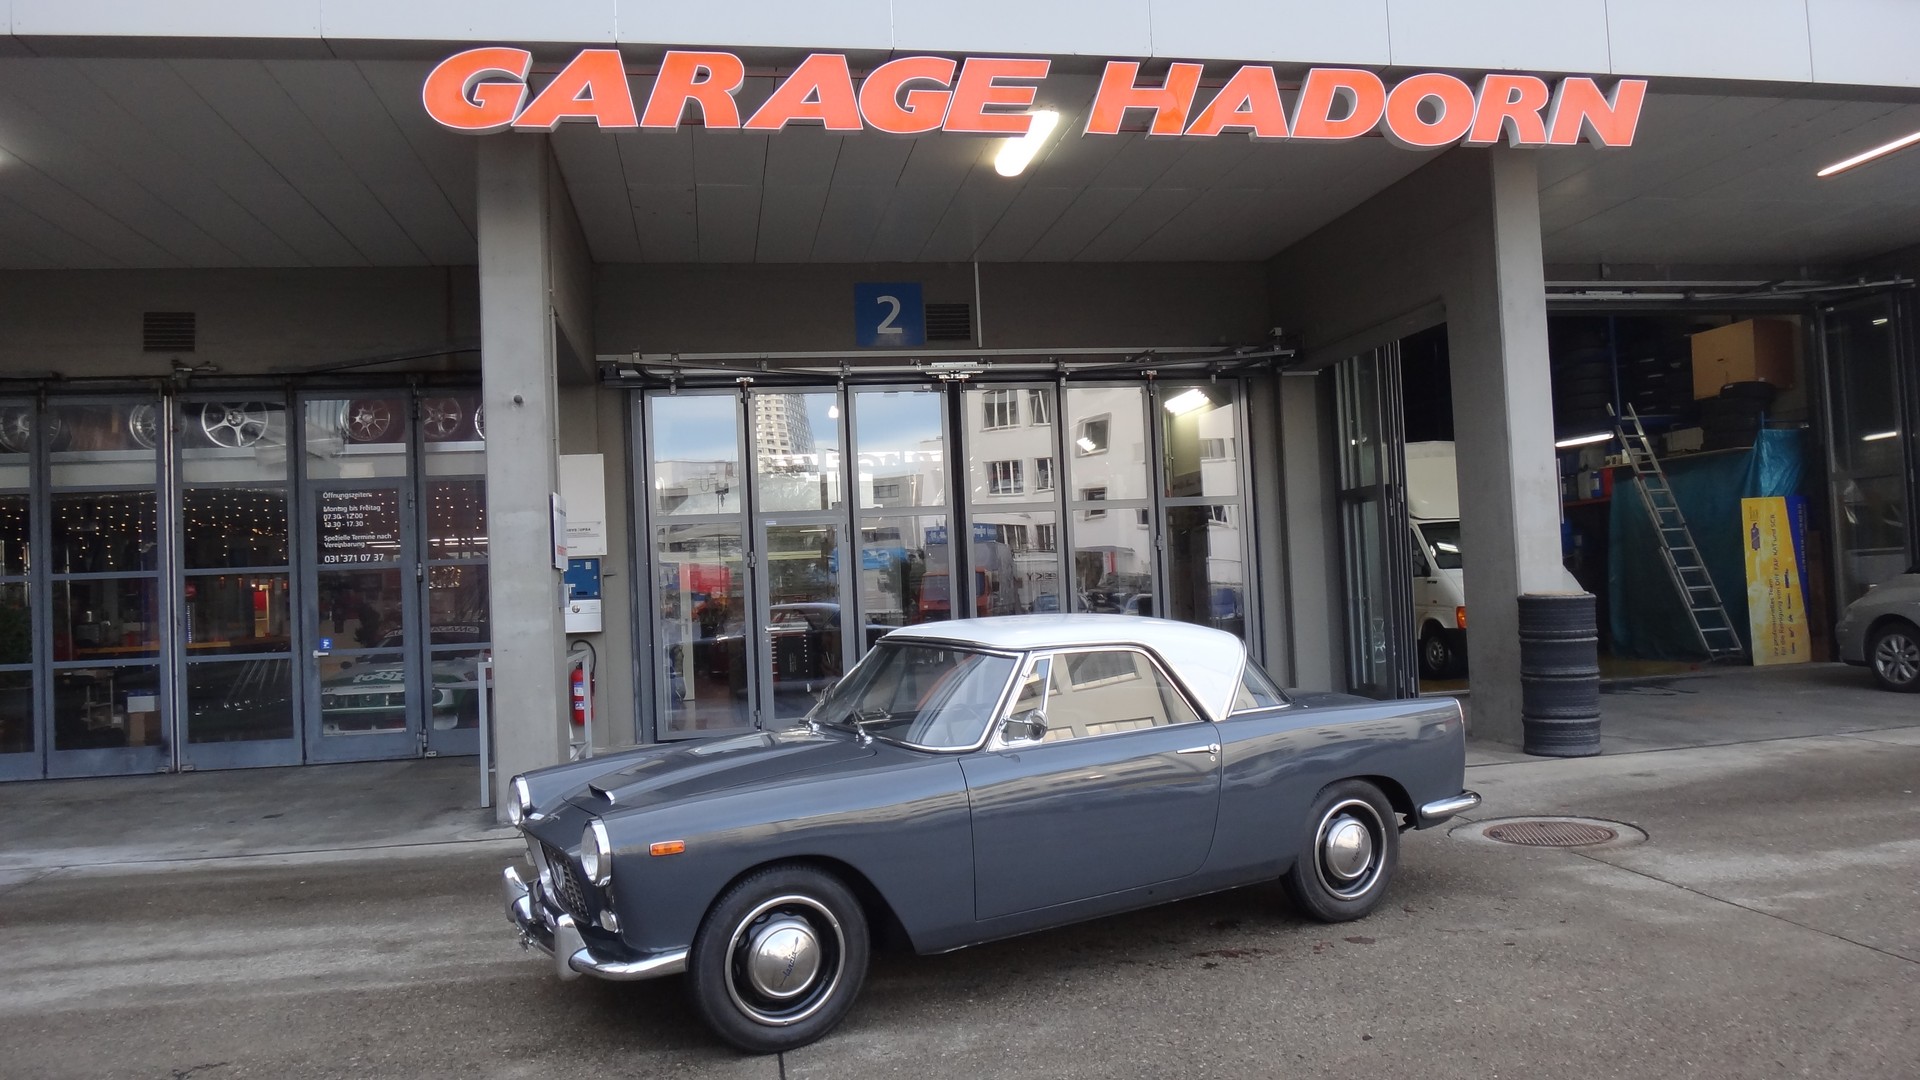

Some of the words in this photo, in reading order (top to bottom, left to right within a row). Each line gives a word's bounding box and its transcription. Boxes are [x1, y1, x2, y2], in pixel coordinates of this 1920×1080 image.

[422, 46, 1052, 135] GARAGE
[1084, 59, 1649, 148] HADORN
[876, 295, 903, 334] 2
[359, 504, 381, 512] Freitag
[323, 534, 351, 542] Spezielle
[351, 533, 376, 541] Termine
[323, 541, 366, 549] Vereinbarung
[324, 555, 340, 563] 031
[342, 554, 358, 563] 371
[360, 553, 371, 562] 07
[373, 553, 385, 562] 37
